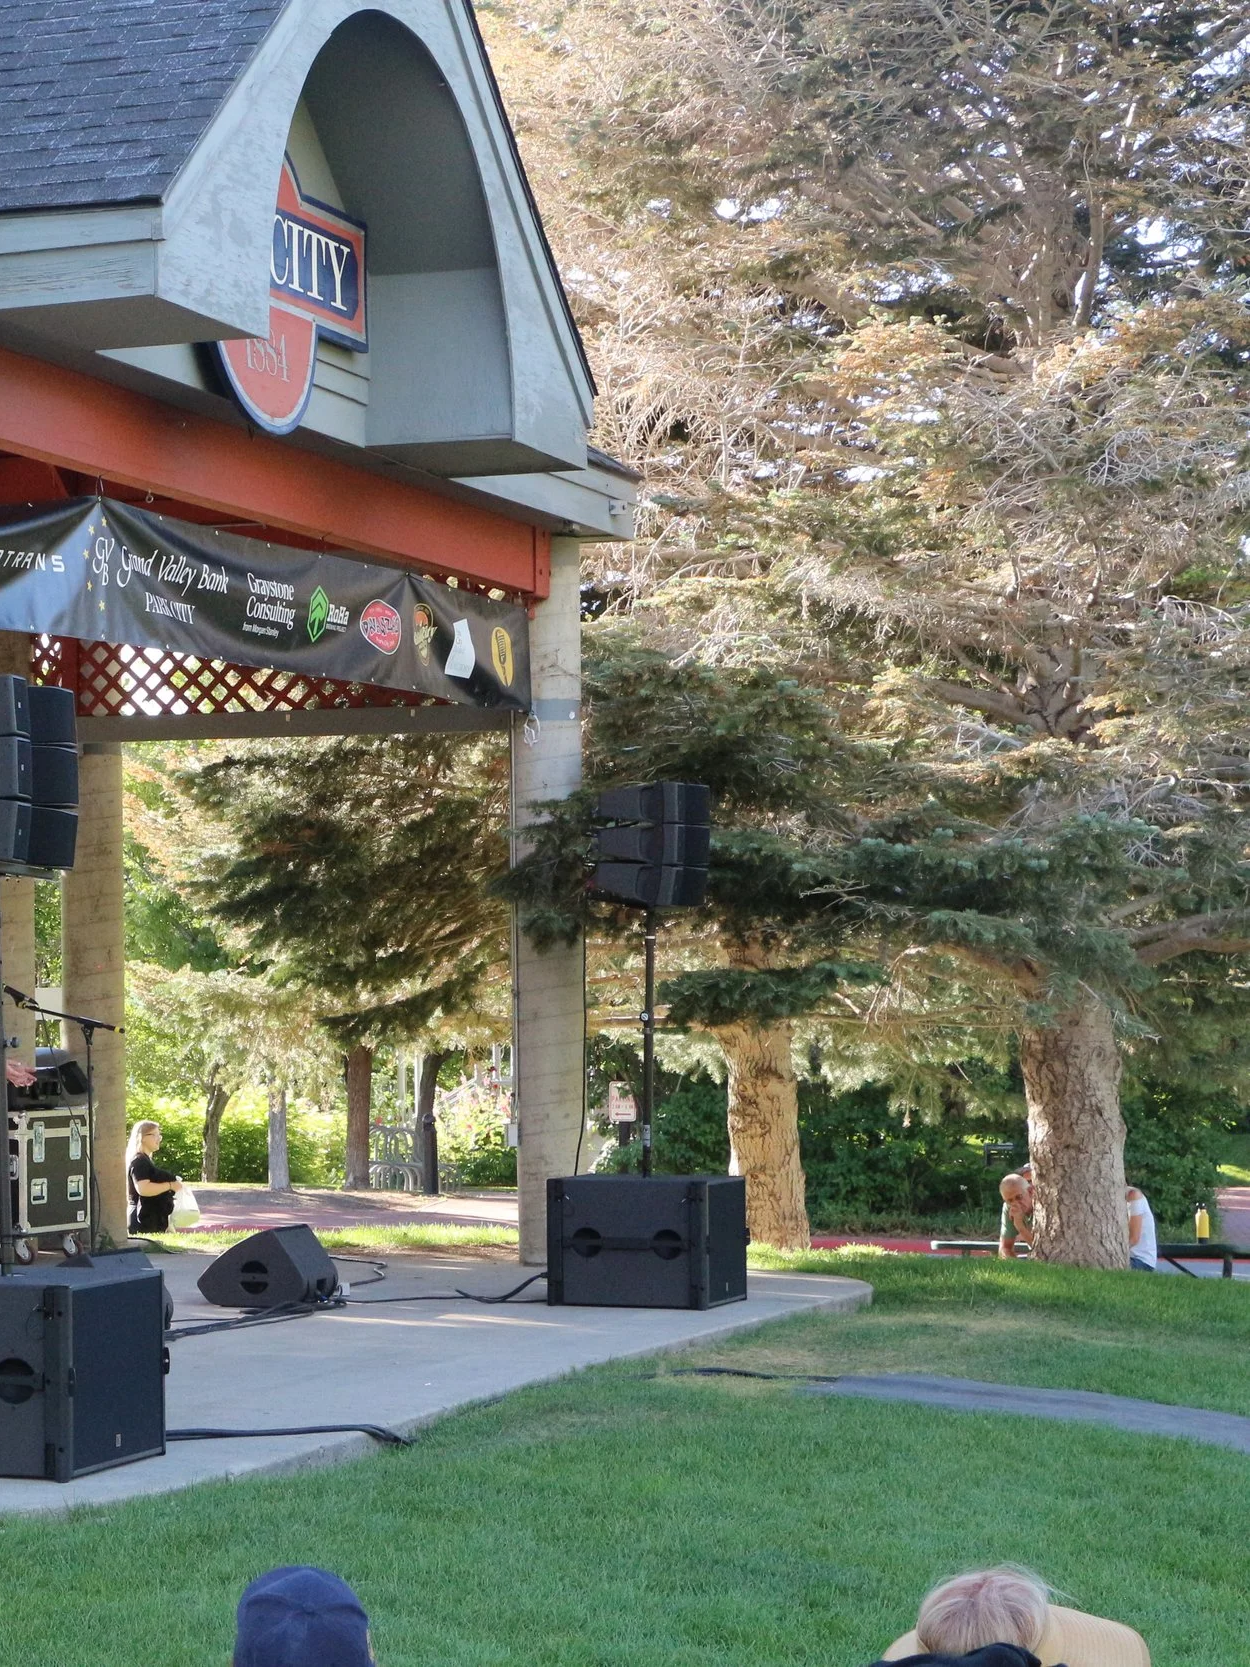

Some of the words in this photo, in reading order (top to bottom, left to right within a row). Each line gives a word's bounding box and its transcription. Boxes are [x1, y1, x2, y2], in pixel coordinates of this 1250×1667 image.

[270, 214, 350, 311] CITY
[116, 546, 158, 588] Grand
[158, 554, 198, 596] Valley
[197, 563, 230, 594] Bank
[247, 572, 295, 601] Graystone
[145, 591, 170, 618] PARK
[170, 600, 195, 625] CITY
[246, 596, 296, 630] Consulting
[327, 603, 350, 625] RoHa
